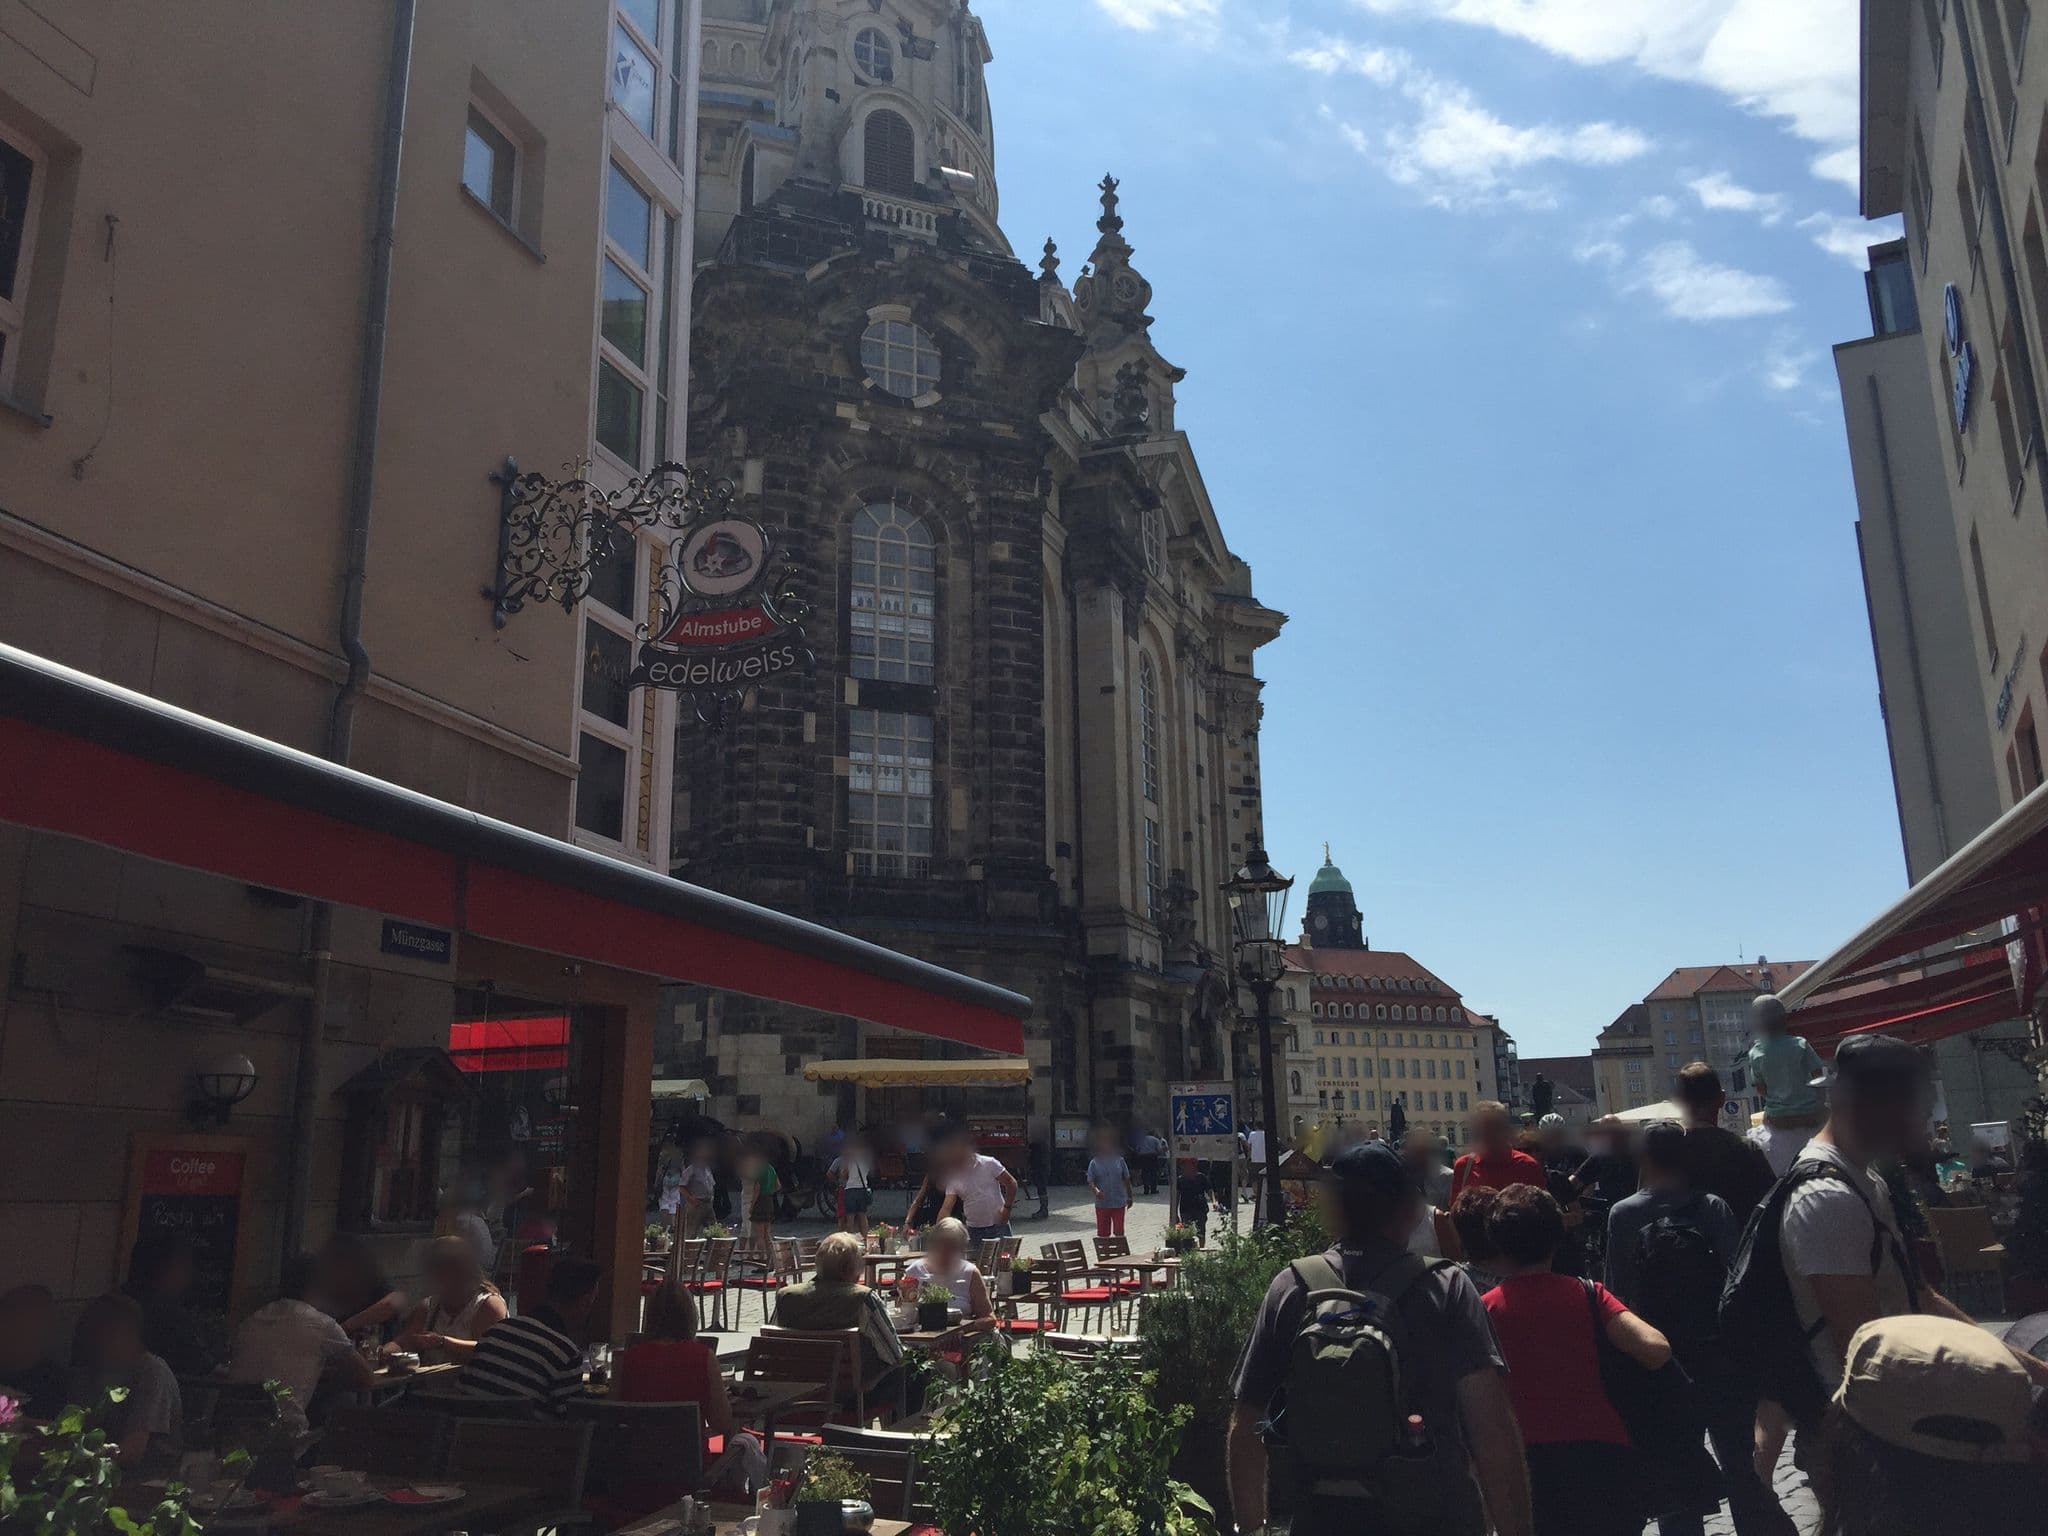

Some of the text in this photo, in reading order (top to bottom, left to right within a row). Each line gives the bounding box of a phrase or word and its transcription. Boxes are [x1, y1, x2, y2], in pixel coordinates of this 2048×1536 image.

[680, 616, 763, 637] Almstube
[649, 646, 795, 685] edelweiss
[391, 927, 446, 953] Münzgasse
[170, 1157, 217, 1175] Coffee
